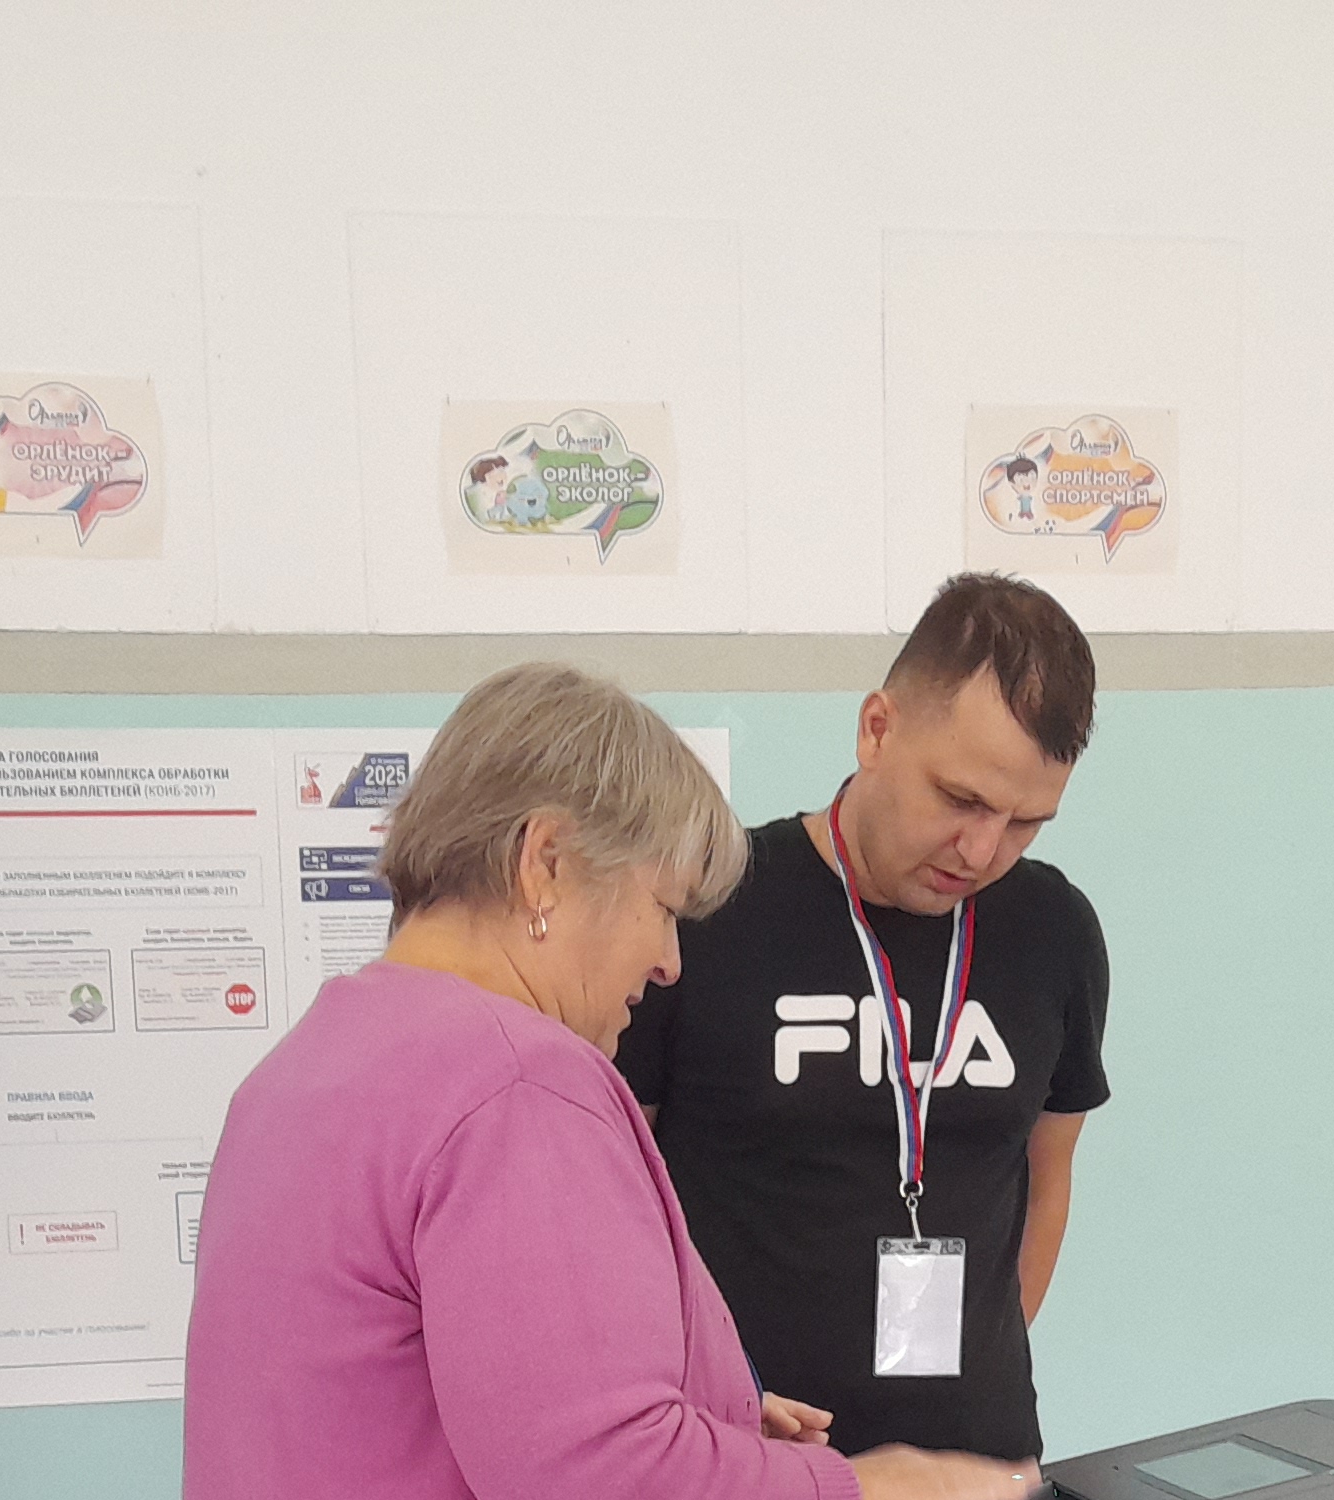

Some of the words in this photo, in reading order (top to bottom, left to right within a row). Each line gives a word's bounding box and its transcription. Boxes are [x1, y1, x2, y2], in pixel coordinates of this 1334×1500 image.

[31, 464, 111, 485] ЭРУДИТ
[557, 486, 633, 503] ЭКОЛОГ
[1043, 489, 1148, 506] СПОРТСМЕН
[8, 750, 99, 763] ГОЛОСОВАНИЯ
[80, 767, 155, 780] КОМПЛЕКСА
[158, 767, 229, 780] ОБРАБОТКИ
[364, 764, 407, 786] 2025
[60, 783, 142, 798] БЮЛЛЕТЕНЕЙ
[227, 991, 254, 1007] STOP
[774, 994, 1016, 1088] FILA
